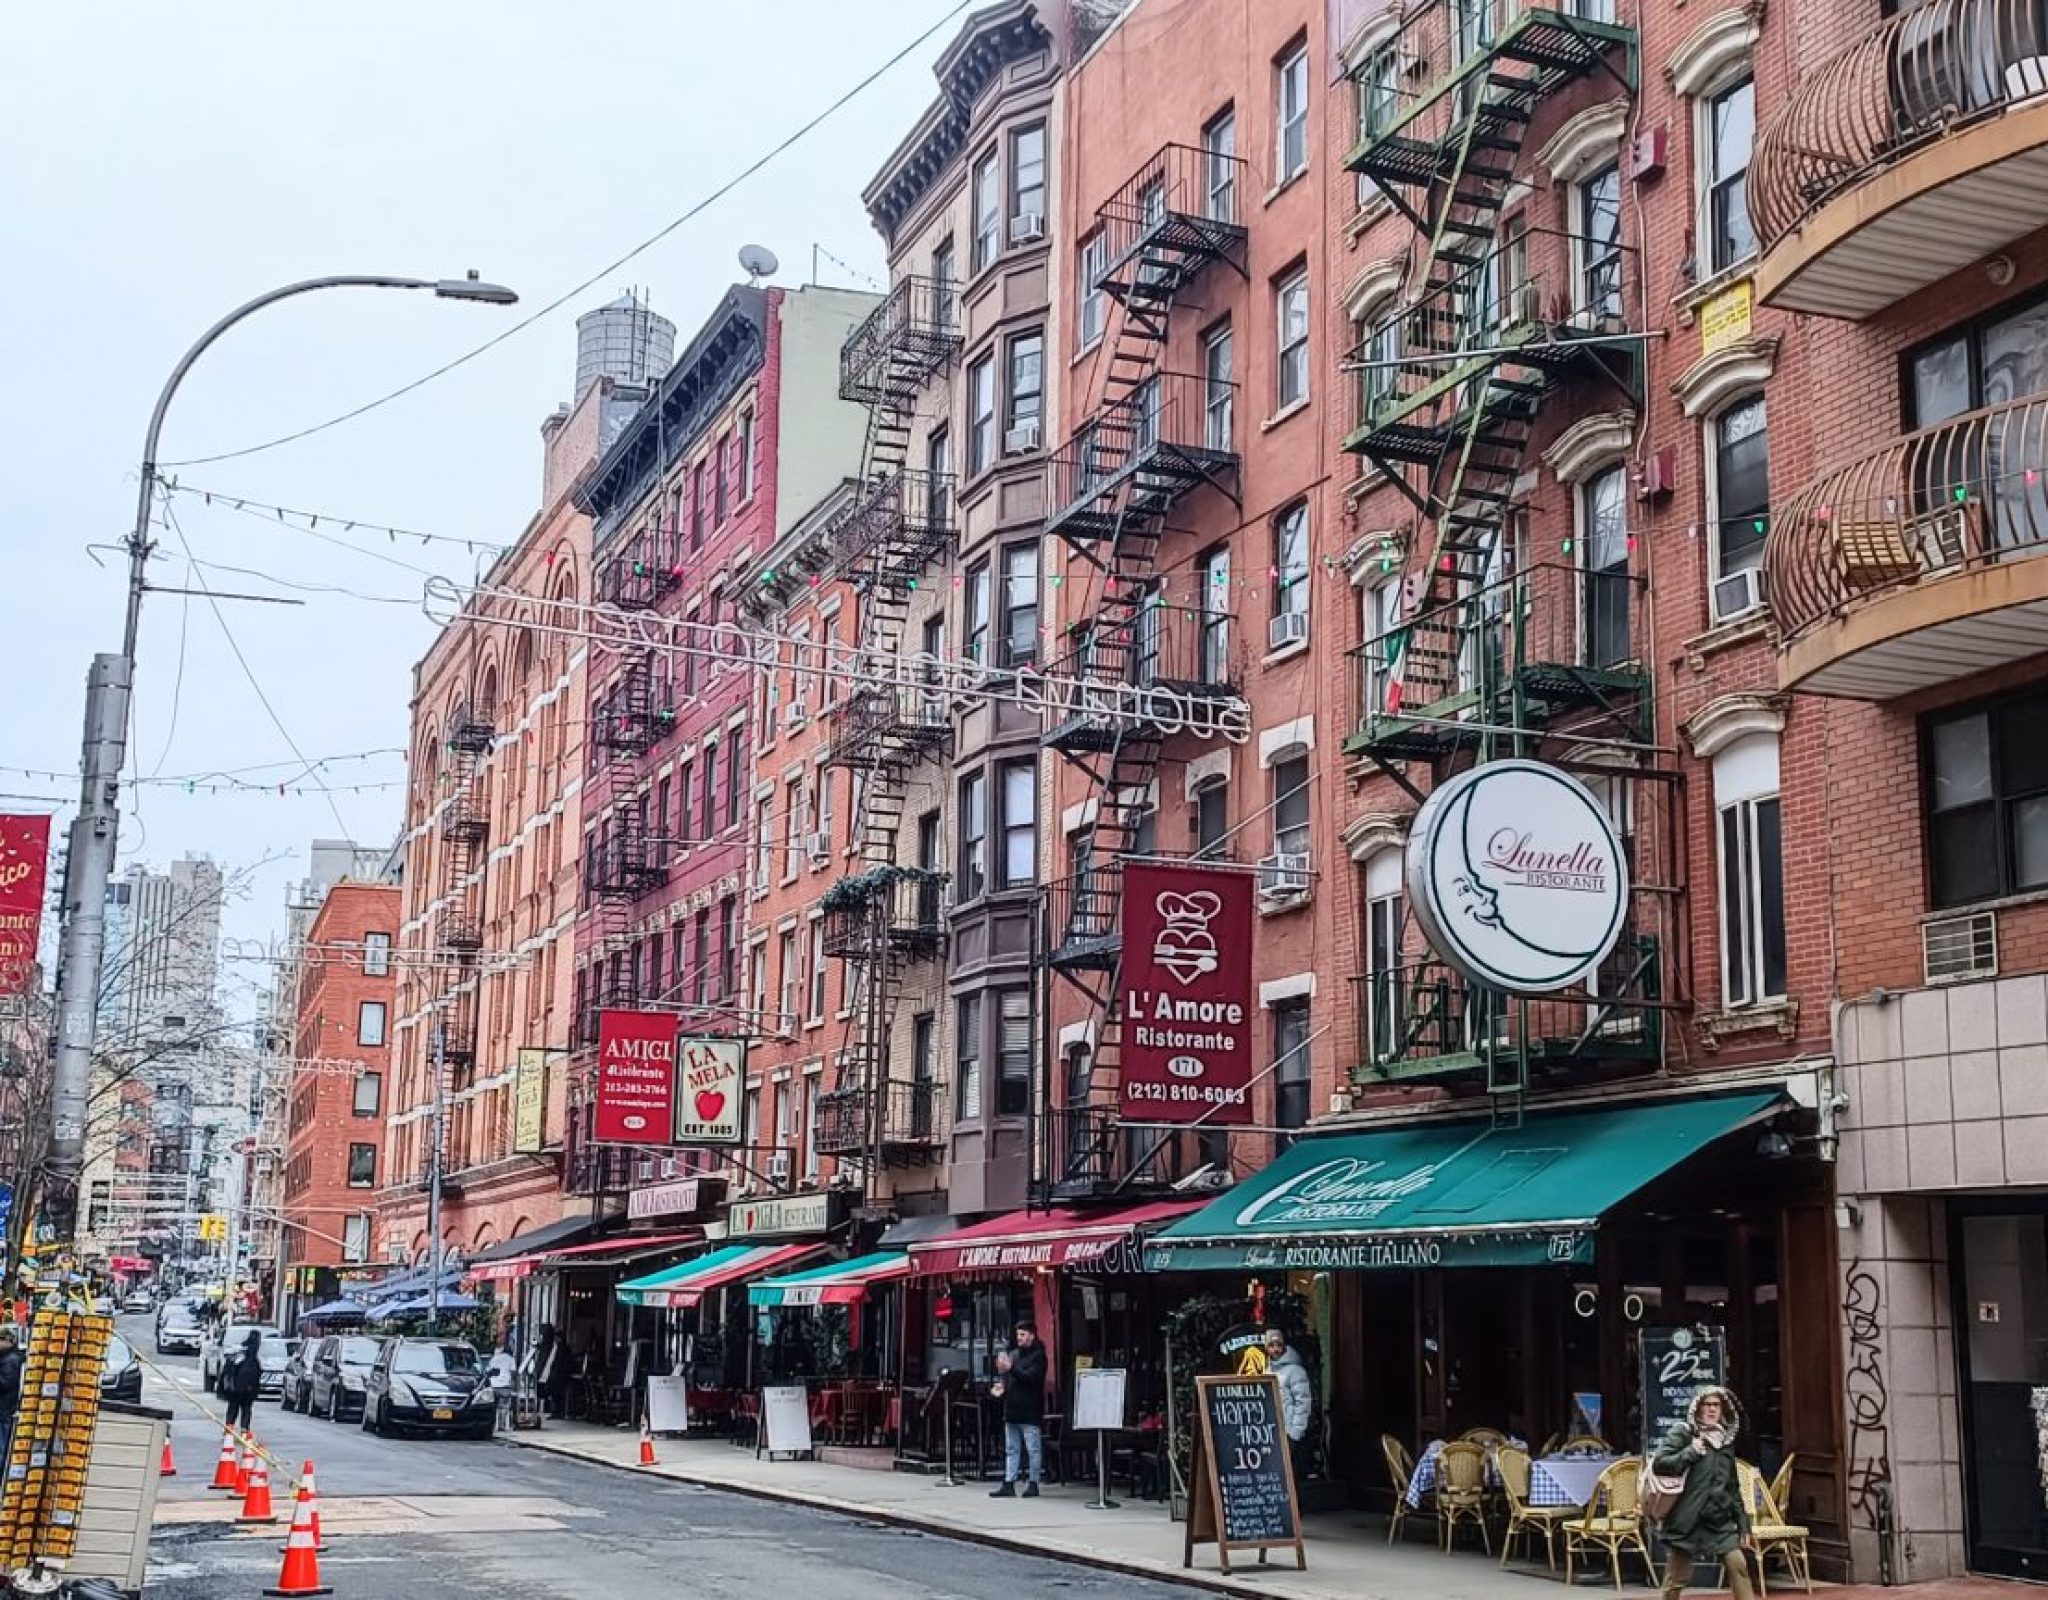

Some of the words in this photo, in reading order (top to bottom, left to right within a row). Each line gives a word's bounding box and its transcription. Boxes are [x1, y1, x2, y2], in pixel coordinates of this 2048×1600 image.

[1481, 826, 1604, 876] Lunella
[1526, 872, 1607, 891] RISTORANTE
[604, 1038, 673, 1062] AMICI
[1135, 1026, 1235, 1051] Ristorante
[687, 1045, 718, 1070] LA
[1174, 1058, 1197, 1075] 171
[687, 1062, 736, 1090] MELA
[1127, 1081, 1167, 1102] (212)
[1000, 1244, 1053, 1264] RISTORANTE
[1284, 1246, 1365, 1266] RISTORANTE
[1371, 1243, 1440, 1265] ITALIANO
